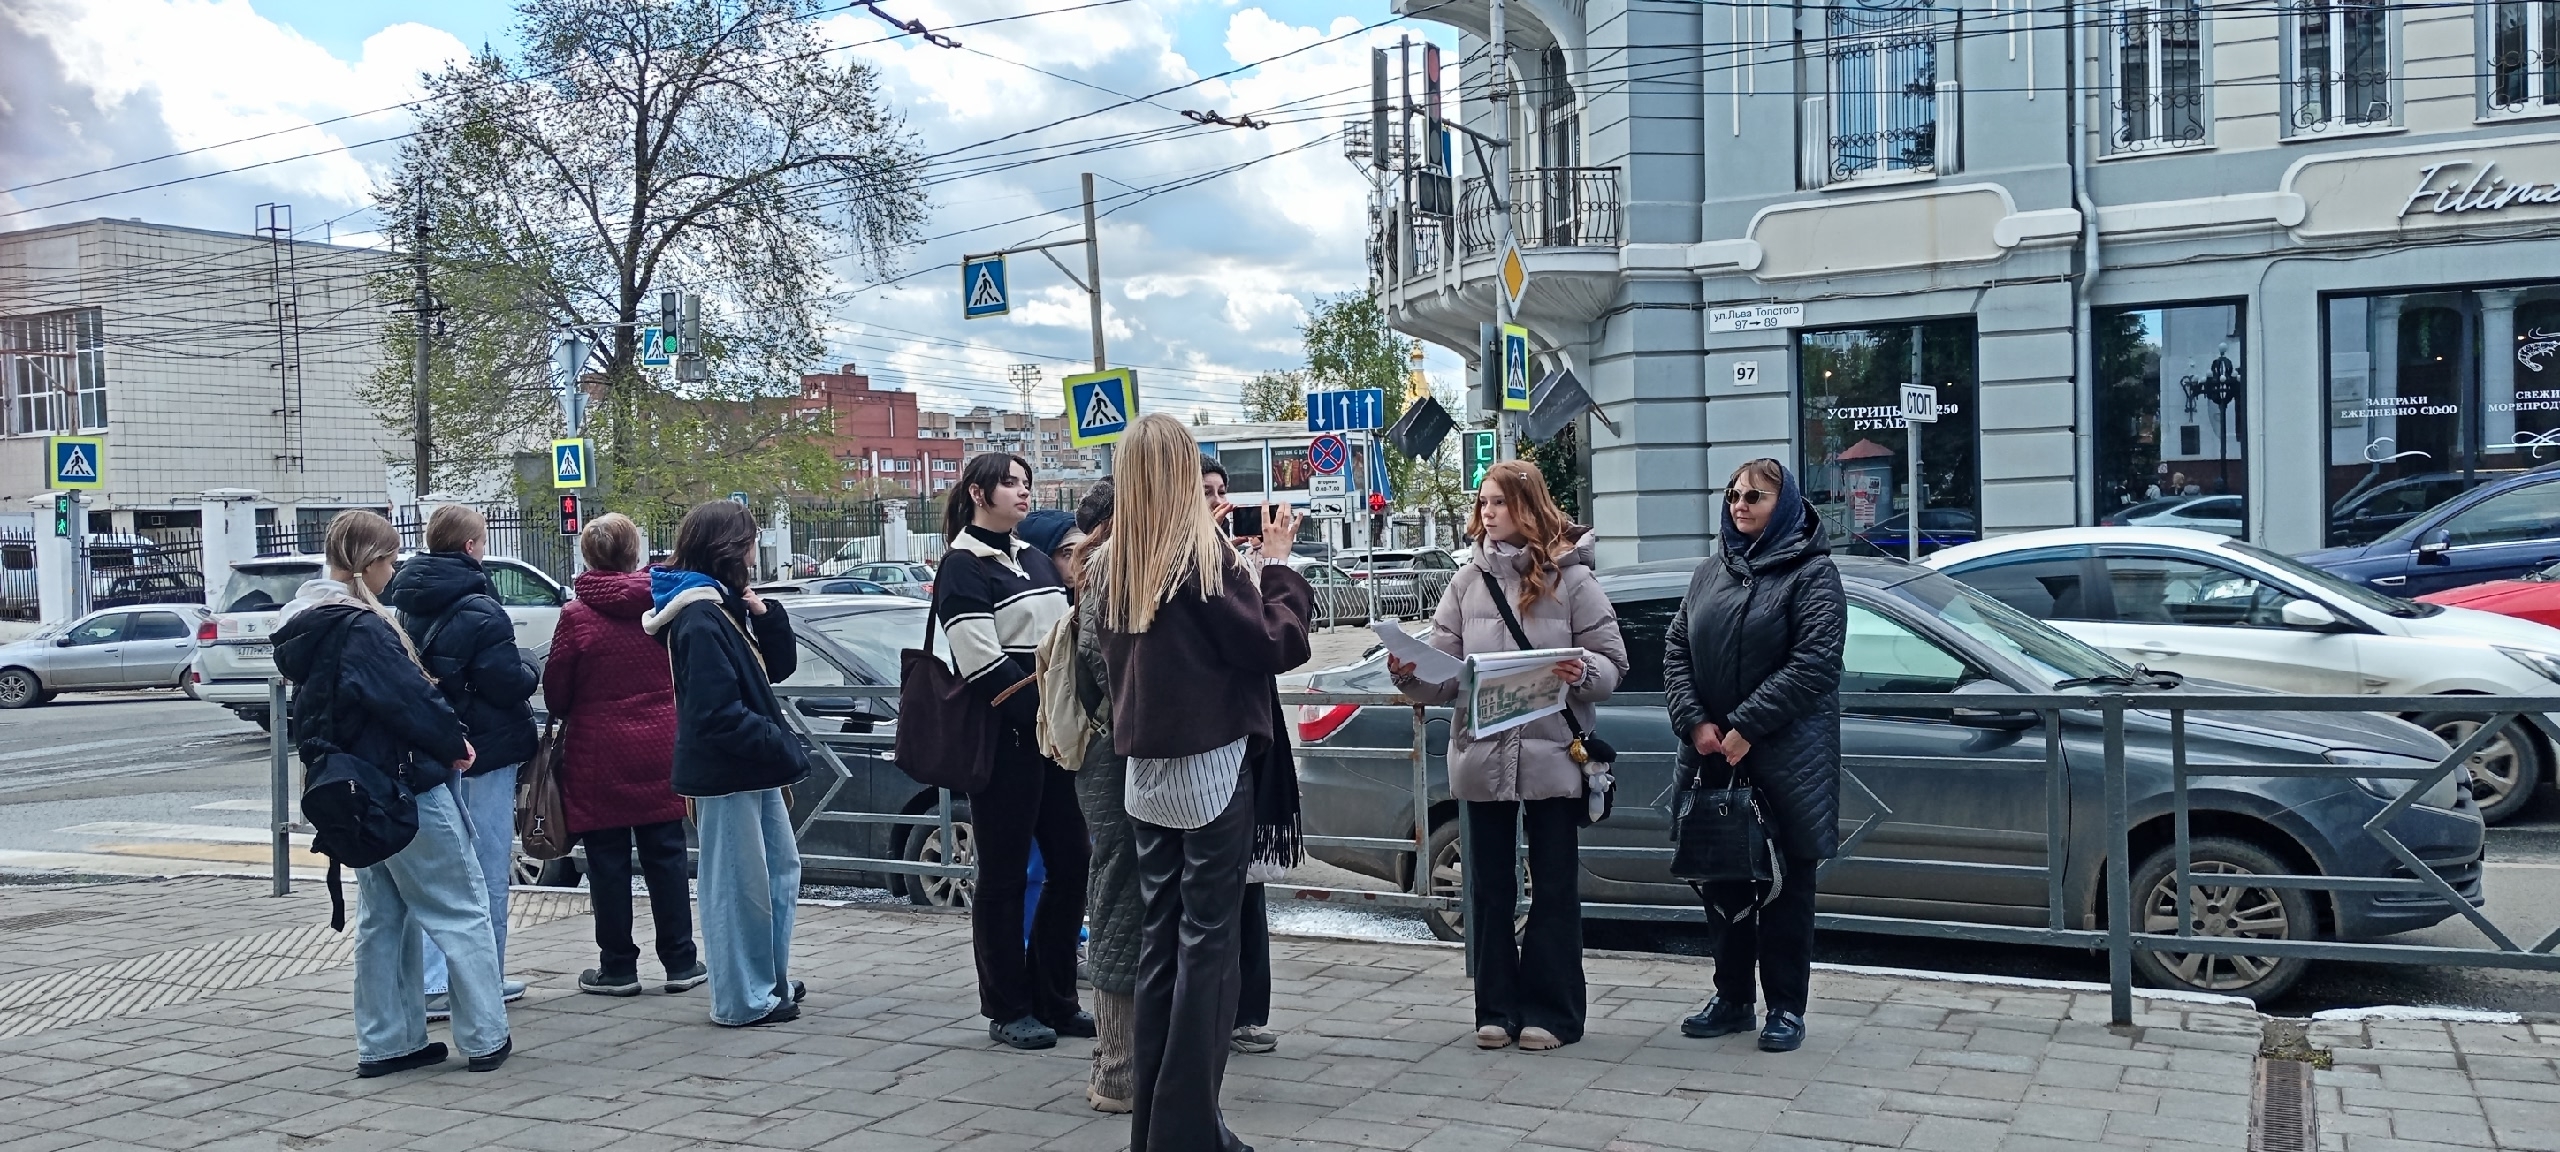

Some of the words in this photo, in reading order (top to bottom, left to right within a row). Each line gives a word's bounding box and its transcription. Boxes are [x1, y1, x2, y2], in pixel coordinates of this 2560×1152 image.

[1714, 309, 1752, 322] ул.Льва
[1755, 306, 1799, 317] Толстого
[1734, 319, 1748, 330] 97
[1764, 317, 1778, 327] 89
[1737, 367, 1755, 381] 97
[1907, 391, 1931, 416] СТОП
[2366, 396, 2428, 406] ЗАВТРАКИ
[2488, 401, 2560, 412] МОРЕПРОД
[1936, 403, 1959, 415] 250
[2340, 407, 2417, 418] ЕЖЕДНЕВНО
